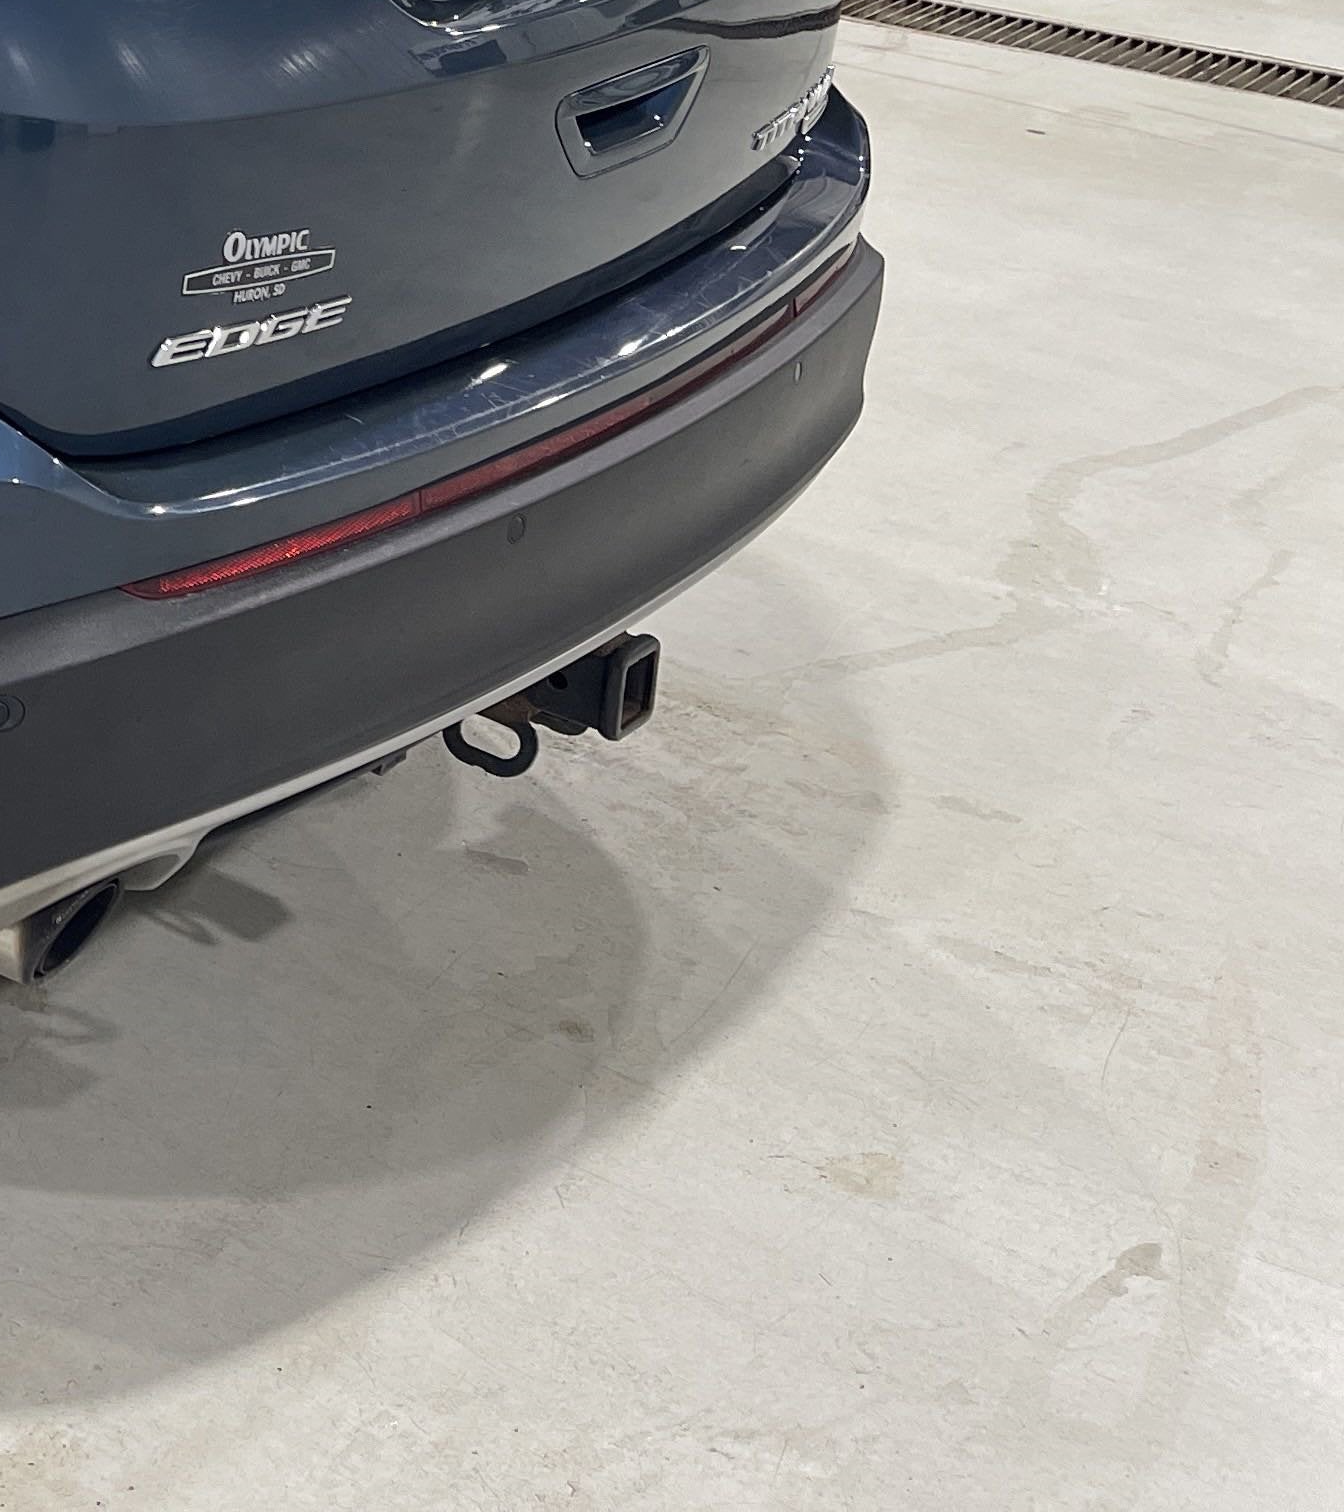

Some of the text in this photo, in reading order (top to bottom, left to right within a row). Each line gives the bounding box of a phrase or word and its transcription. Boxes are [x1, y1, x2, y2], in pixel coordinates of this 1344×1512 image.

[223, 228, 310, 263] OLYMPIC
[212, 270, 244, 286] CHEVY
[253, 263, 281, 279] BUICK
[290, 258, 311, 272] GMC
[272, 283, 286, 296] SD
[151, 295, 353, 368] EDGE
